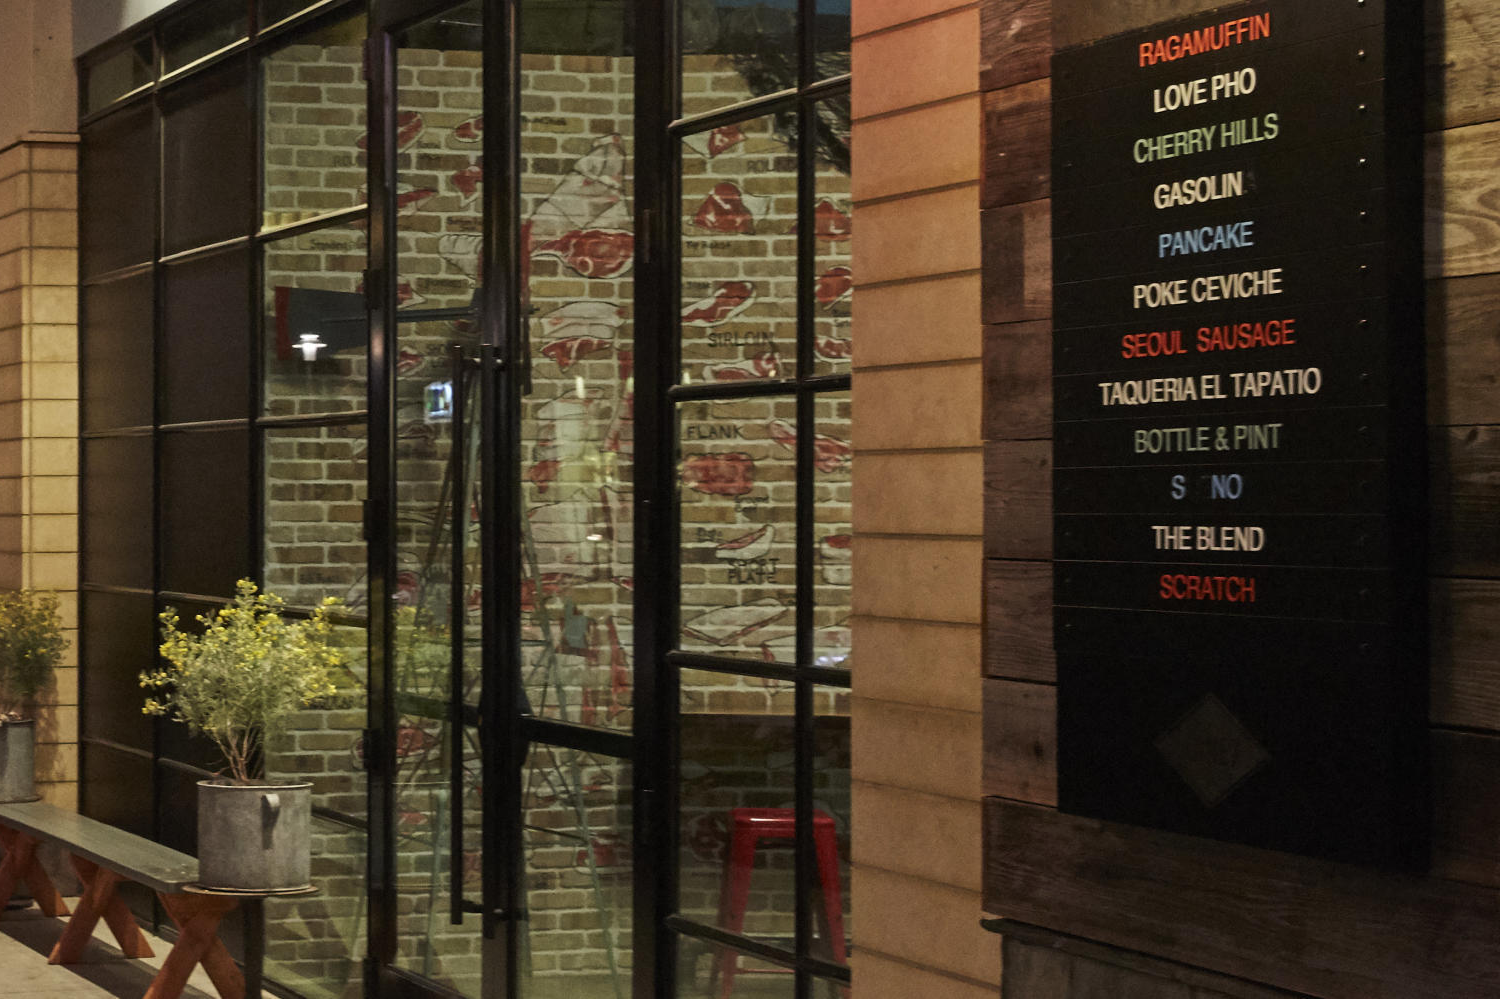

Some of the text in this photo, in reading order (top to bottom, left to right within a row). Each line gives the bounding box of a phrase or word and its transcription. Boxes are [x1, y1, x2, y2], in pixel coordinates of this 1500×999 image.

[1138, 11, 1270, 68] RAGAMUFFIN
[1153, 67, 1257, 113] LOVE PHO
[1133, 112, 1279, 164] CHERRY HILLS
[1153, 171, 1243, 210] GASOLIN
[1158, 221, 1255, 258] PANCAKE
[1133, 268, 1284, 309] POKE CEVICHE
[1121, 319, 1297, 359] SEOUL SAUSAGE
[1098, 367, 1322, 406] TAQUERIA EL TAPATIO
[686, 425, 744, 439] FLANK
[1134, 423, 1284, 454] BOTTLE & PINT
[1211, 473, 1243, 500] NO
[1151, 525, 1266, 552] THE BLEND
[1159, 573, 1256, 603] SCRATCH
